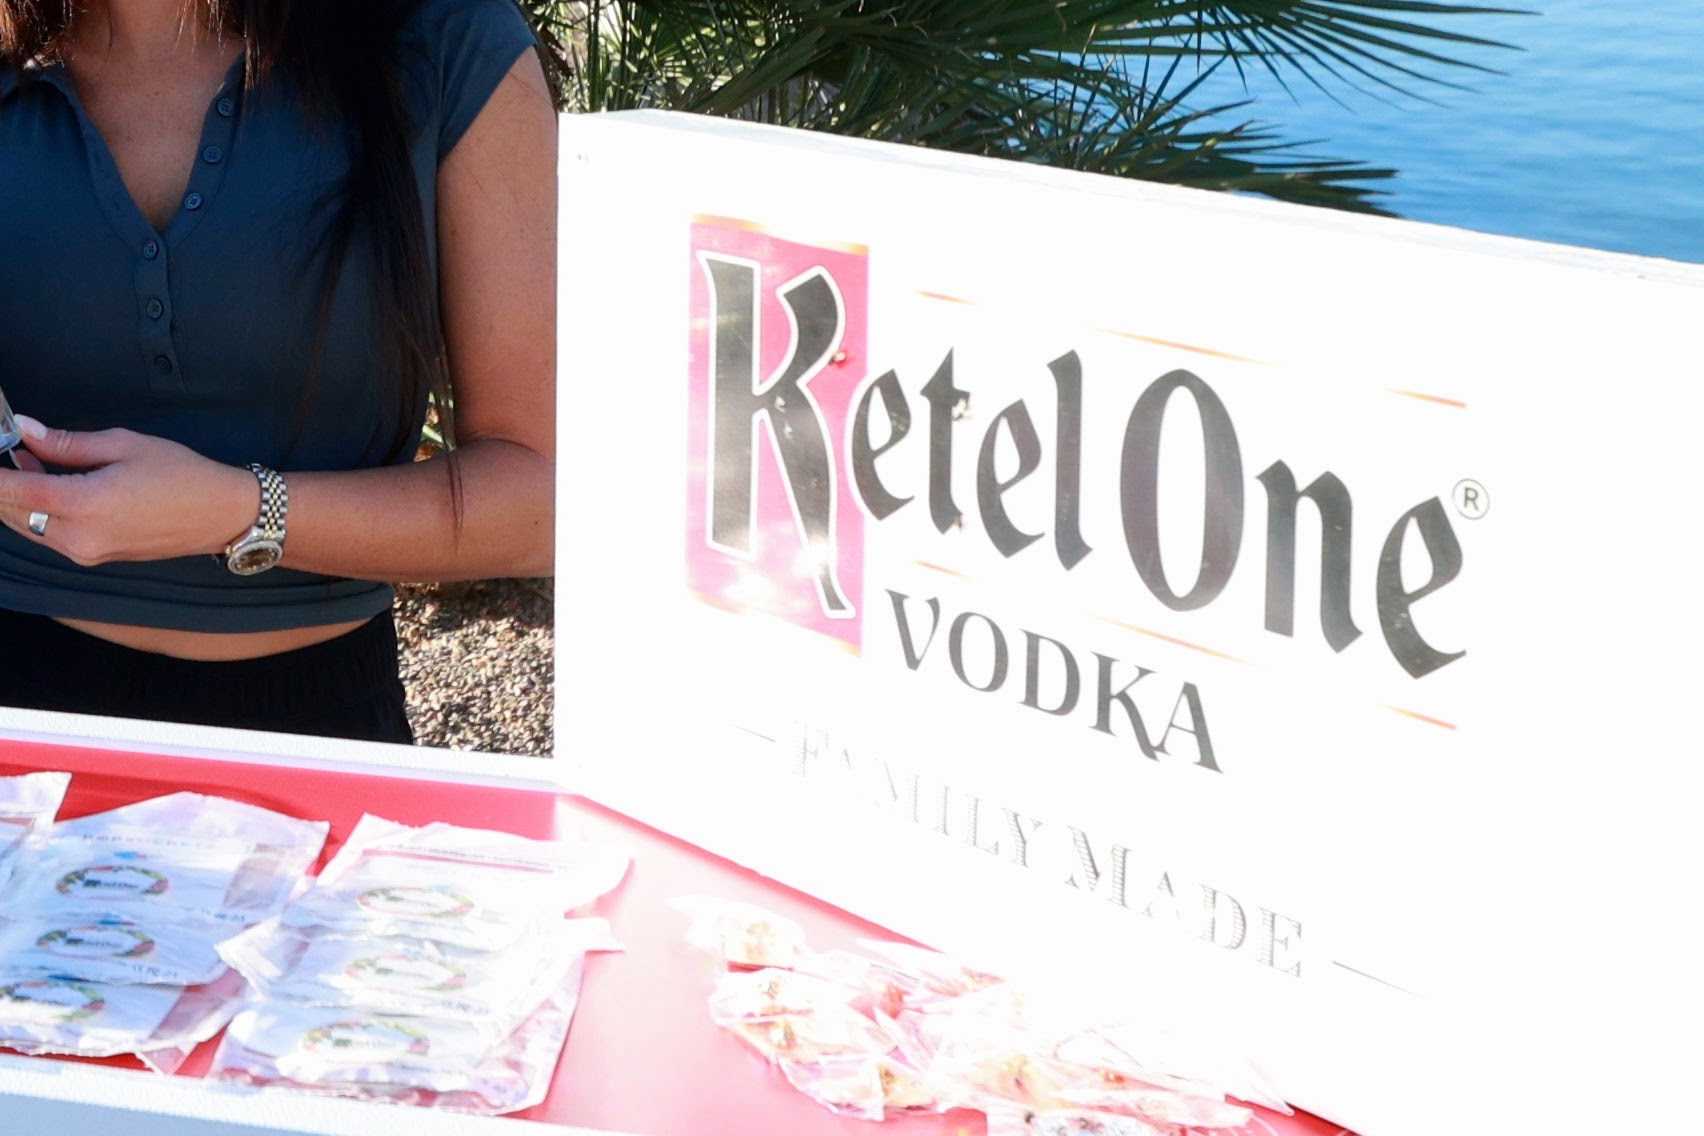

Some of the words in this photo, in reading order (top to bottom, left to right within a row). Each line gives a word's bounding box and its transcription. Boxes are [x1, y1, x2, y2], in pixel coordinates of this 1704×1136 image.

[885, 588, 1225, 775] VODKA
[790, 720, 1044, 869] FMILY
[1064, 822, 1304, 980] MADE
